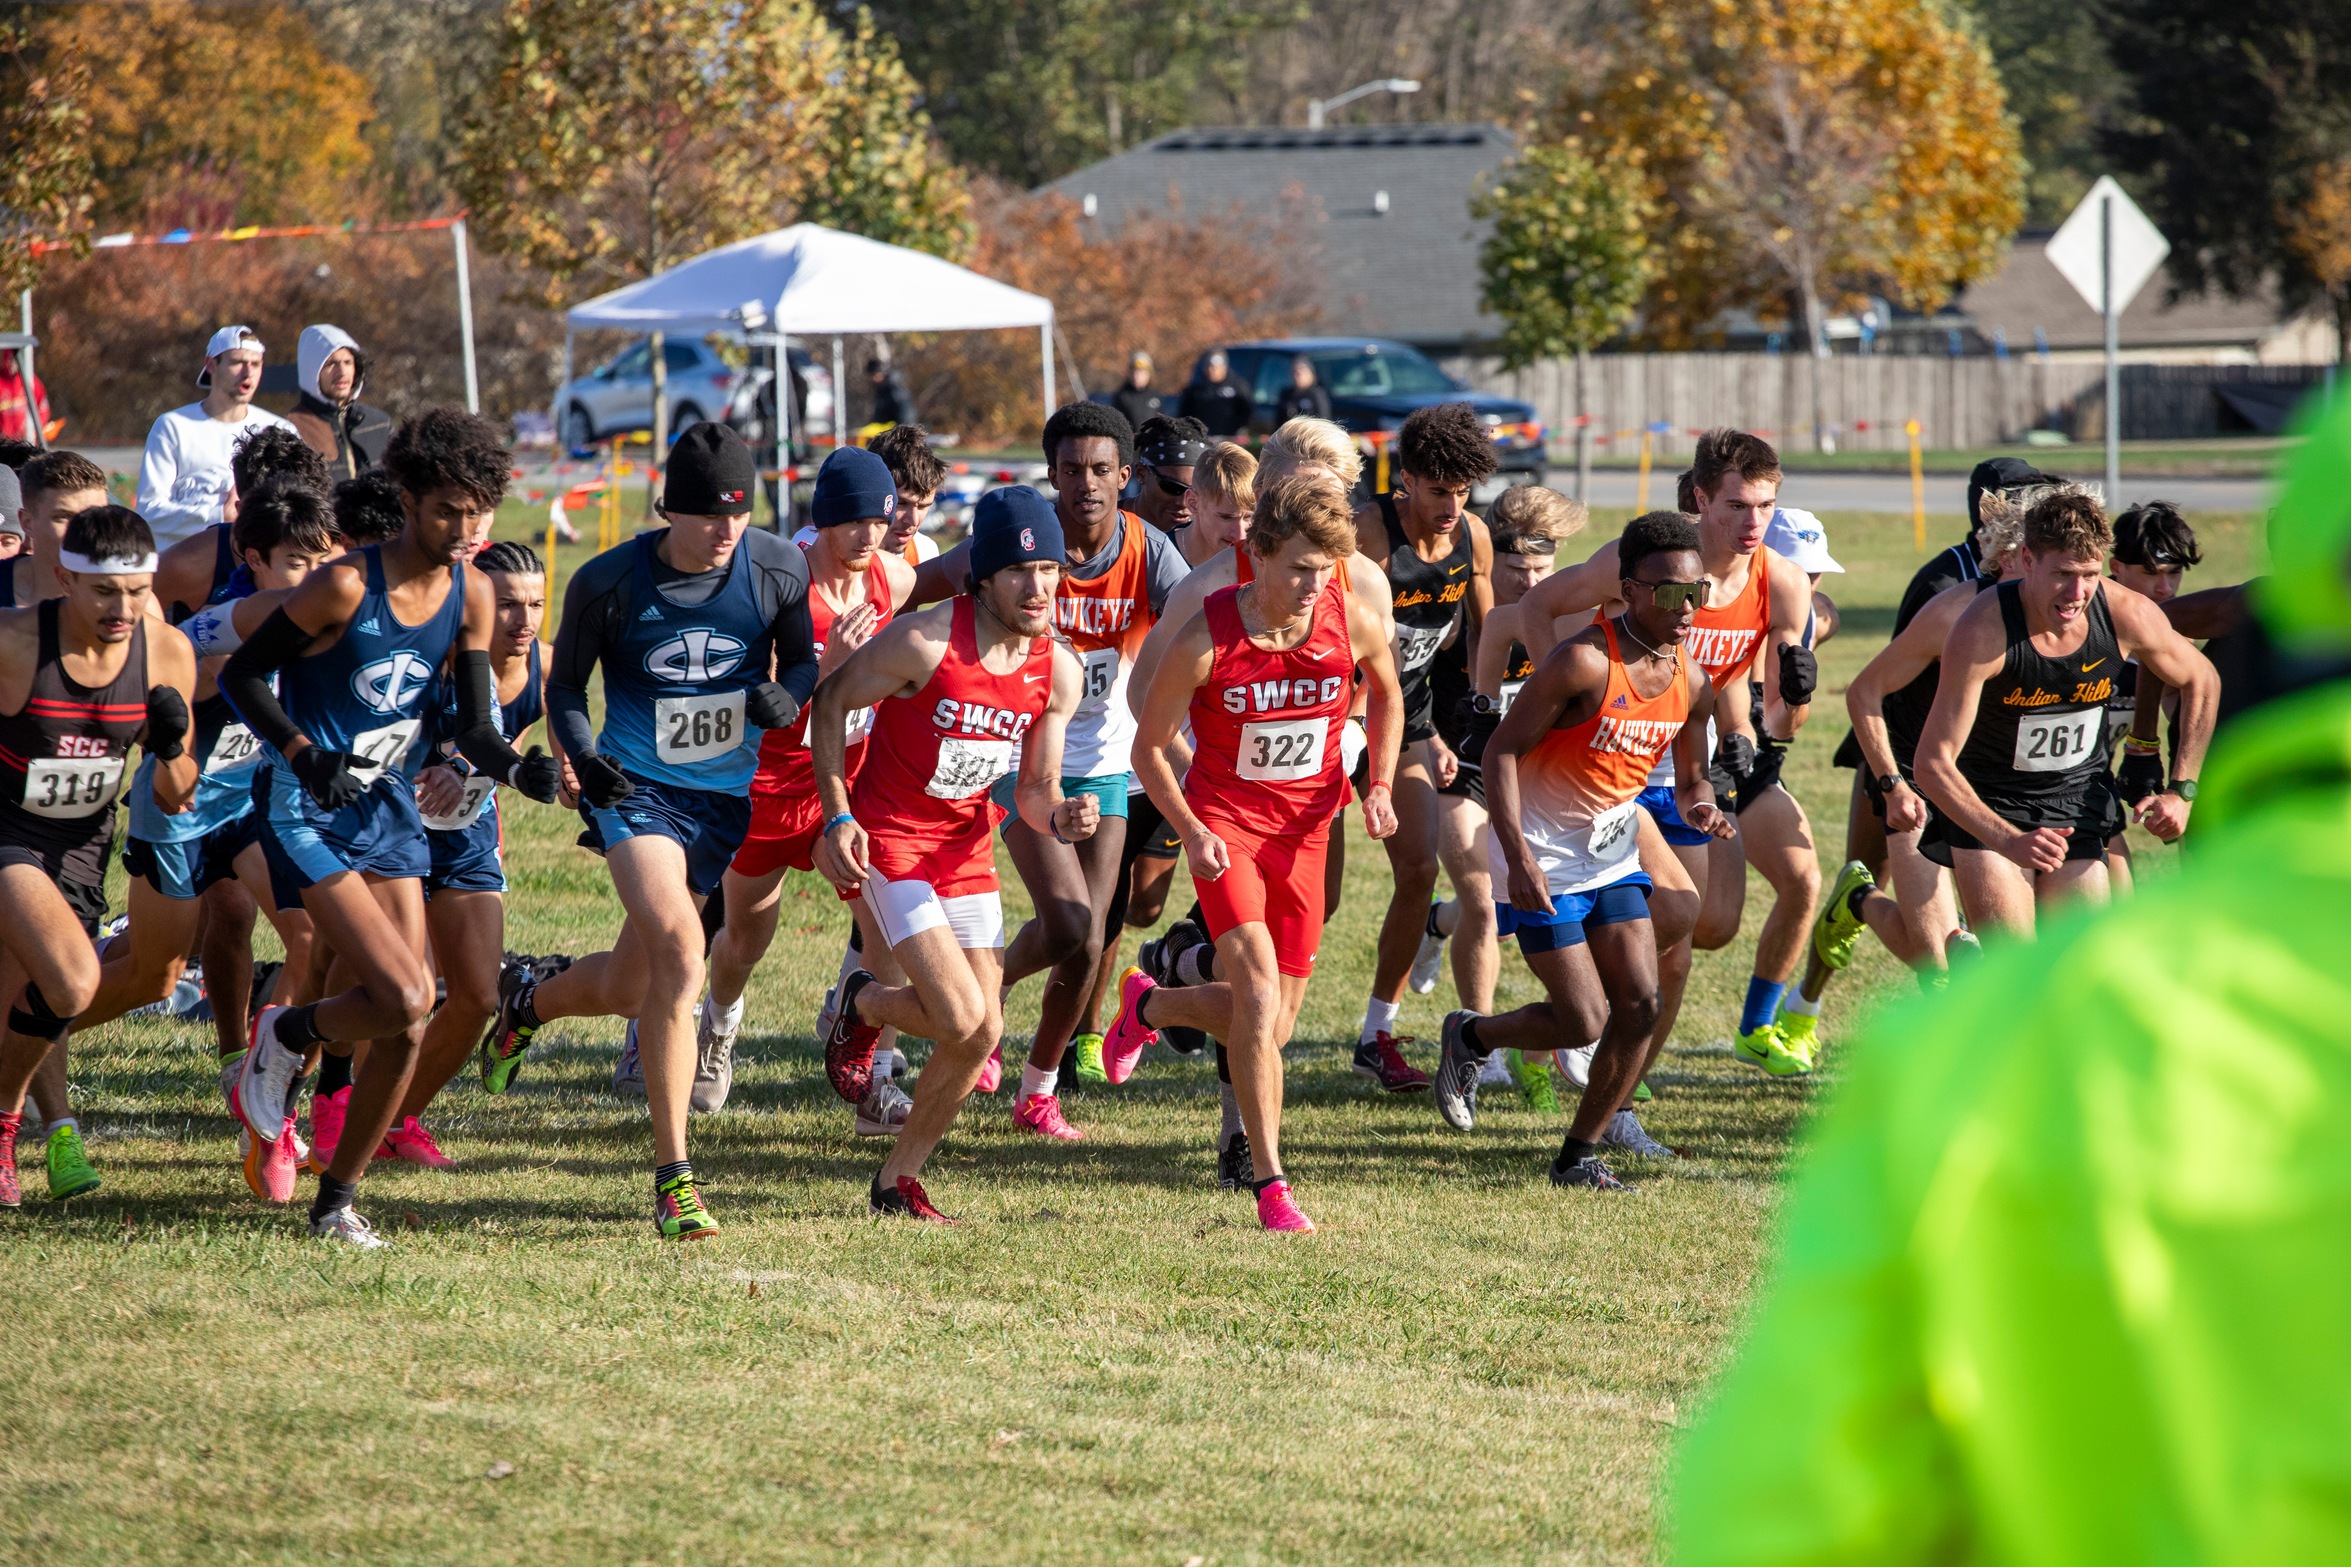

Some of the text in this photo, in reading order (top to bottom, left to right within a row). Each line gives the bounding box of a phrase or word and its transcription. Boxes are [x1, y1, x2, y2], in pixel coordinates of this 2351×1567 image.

[1049, 596, 1134, 634] AWKEYE
[1394, 589, 1433, 607] Indian
[1222, 675, 1342, 715] SWCC
[2003, 687, 2062, 707] Indian
[2069, 677, 2112, 703] Hills
[669, 707, 732, 749] 268
[931, 698, 1033, 741] SWCC
[56, 735, 110, 757] SCC
[1250, 732, 1315, 768] 322
[2027, 723, 2086, 759] 261
[37, 771, 106, 808] 319
